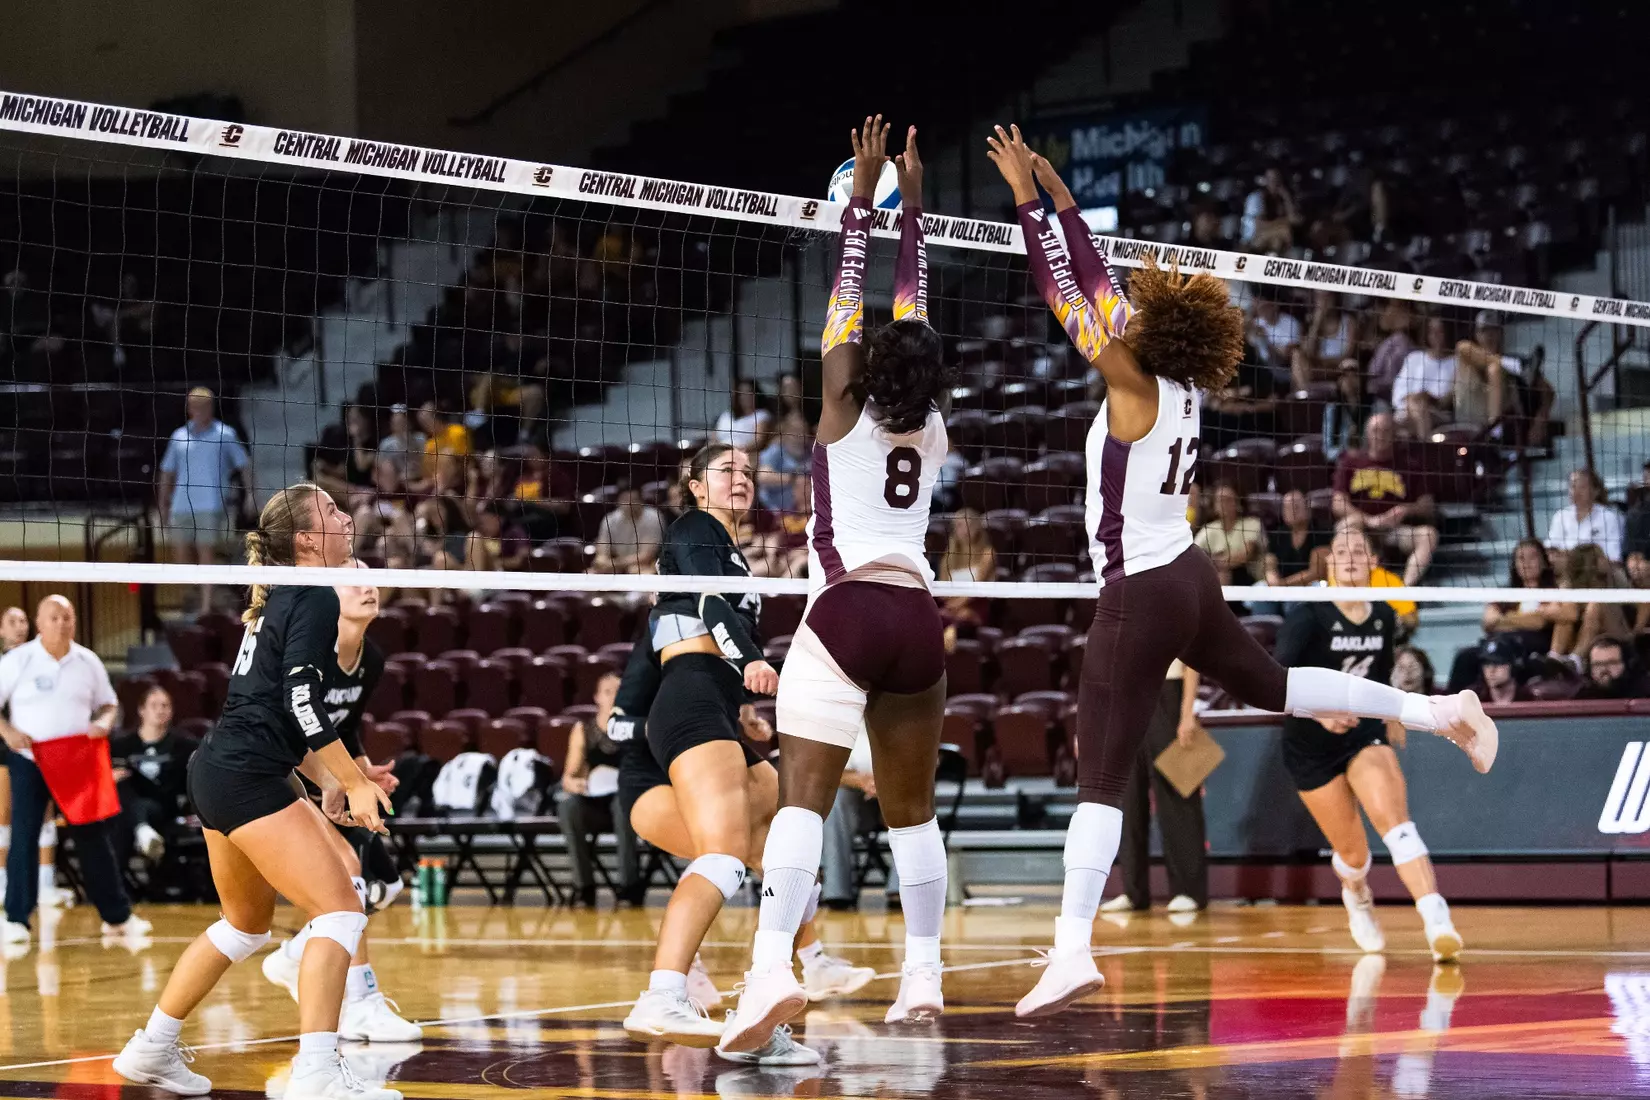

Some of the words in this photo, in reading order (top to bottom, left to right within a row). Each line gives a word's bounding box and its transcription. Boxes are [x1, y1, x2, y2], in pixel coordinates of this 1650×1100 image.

[0, 94, 88, 130] MICHIGAN
[88, 106, 190, 143] VOLLEYBALL
[273, 130, 341, 162] CENTRAL
[344, 140, 421, 172] MICHIGAN
[420, 150, 506, 183] VOLLEYBALL
[579, 171, 637, 199] CENTRAL
[638, 179, 705, 208] MICHIGAN
[704, 186, 780, 217] VOLLEYBALL
[949, 217, 1013, 246] VOLLEYBALL
[1112, 240, 1162, 262] MICHIGAN
[1162, 247, 1217, 270] VOLLEYBALL
[836, 229, 868, 311] CHIPPEWAS
[1038, 229, 1088, 311] CHIPPEWAS
[1264, 259, 1301, 280] CENTRAL
[1303, 264, 1347, 285] MICHIGAN
[1347, 269, 1398, 291] VOLLEYBALL
[1438, 280, 1472, 300] CENTRAL
[1474, 285, 1512, 304] MICHIGAN
[1512, 289, 1557, 309] VOLLEYBALL
[1592, 298, 1623, 317] CENTRAL
[884, 446, 922, 510] 8
[1160, 437, 1200, 495] 12
